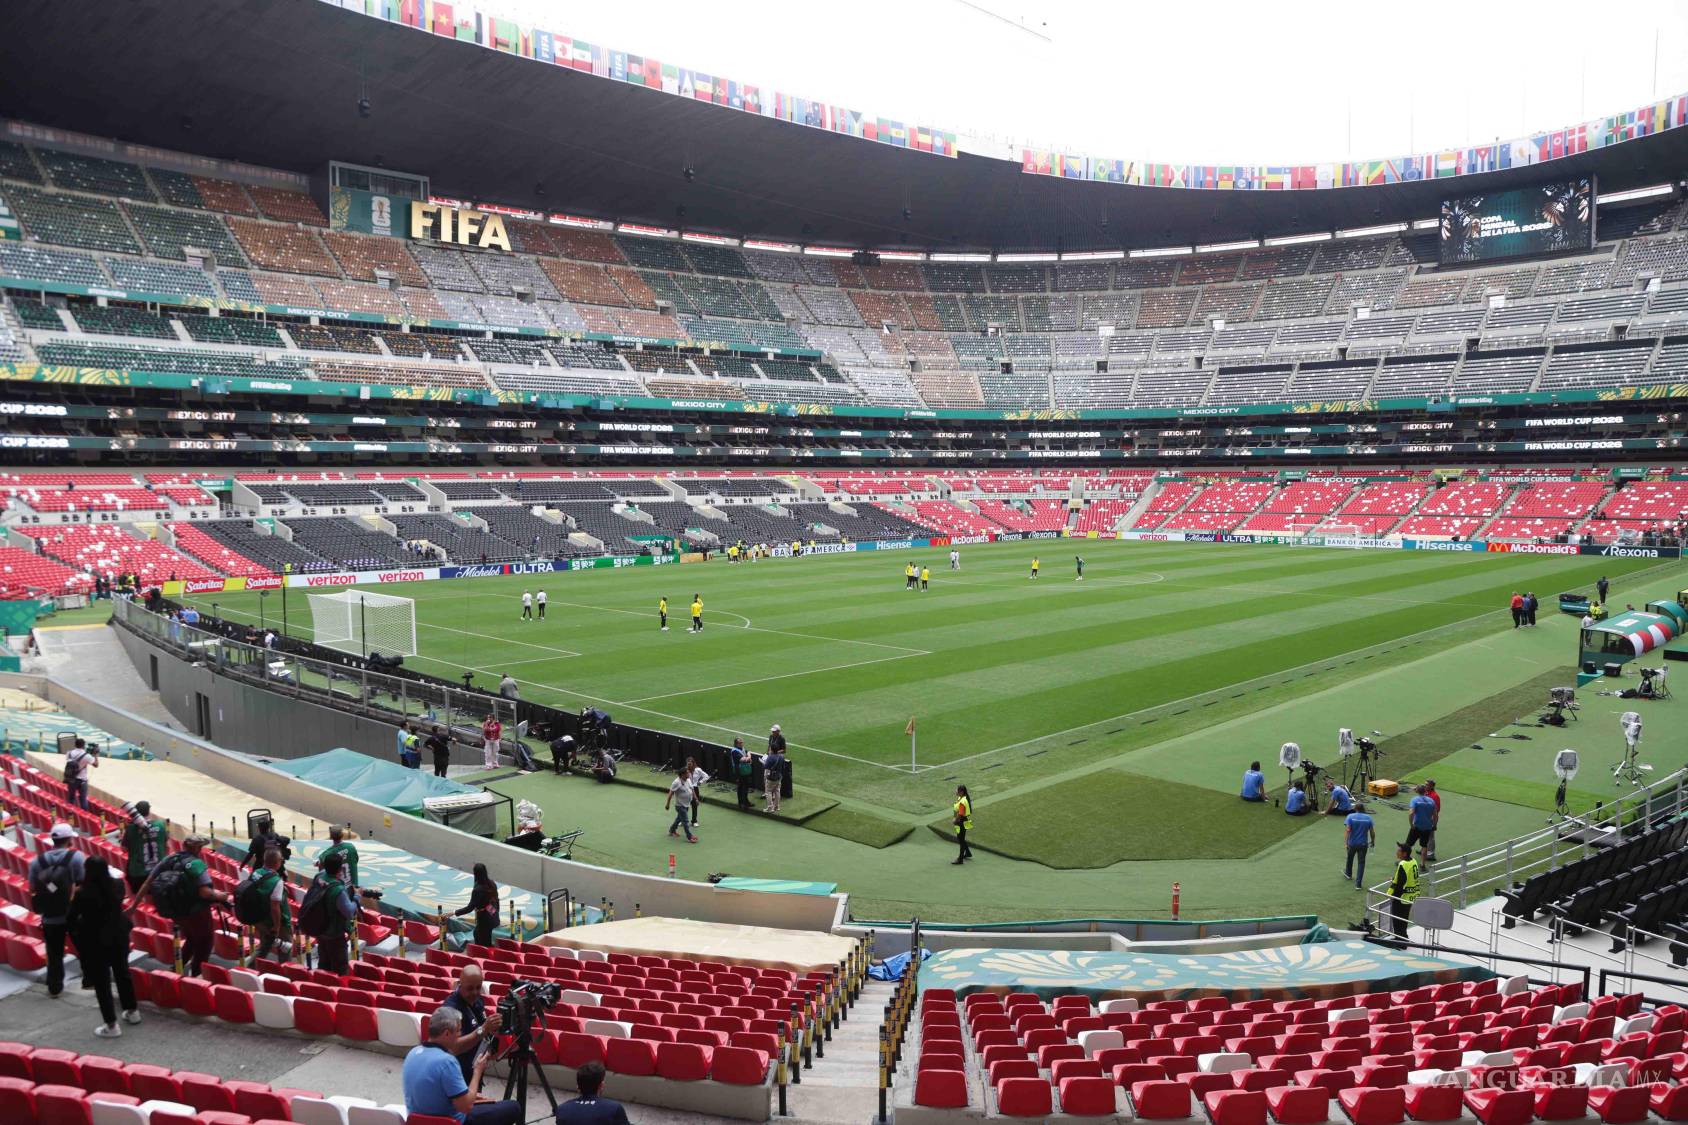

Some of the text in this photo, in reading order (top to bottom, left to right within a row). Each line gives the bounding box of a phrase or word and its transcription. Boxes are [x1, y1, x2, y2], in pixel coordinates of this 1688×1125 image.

[1480, 215, 1502, 224] COPA
[1480, 220, 1516, 230] MUNDIAL
[411, 200, 512, 251] FIFA
[1480, 230, 1493, 238] DE
[1504, 226, 1520, 234] FIFA
[0, 403, 68, 416] CUP 2026
[1544, 418, 1574, 426] WORLD
[1574, 417, 1592, 425] CUP
[1592, 416, 1624, 424] 2026
[614, 424, 637, 432] WORLD
[2, 438, 26, 447] CUP
[950, 535, 990, 544] McDonald's
[1001, 533, 1022, 541] Rexona
[1032, 530, 1056, 538] Rexona
[876, 540, 912, 550] Hisense
[1416, 540, 1472, 551] Hisense
[1510, 544, 1577, 555] McDonald's
[1610, 546, 1658, 558] Rexona
[456, 562, 554, 578] Michelob ULTRA
[307, 574, 356, 586] verizon
[379, 570, 424, 583] verizon
[186, 580, 224, 592] Sabritas
[246, 576, 283, 590] Sabritas
